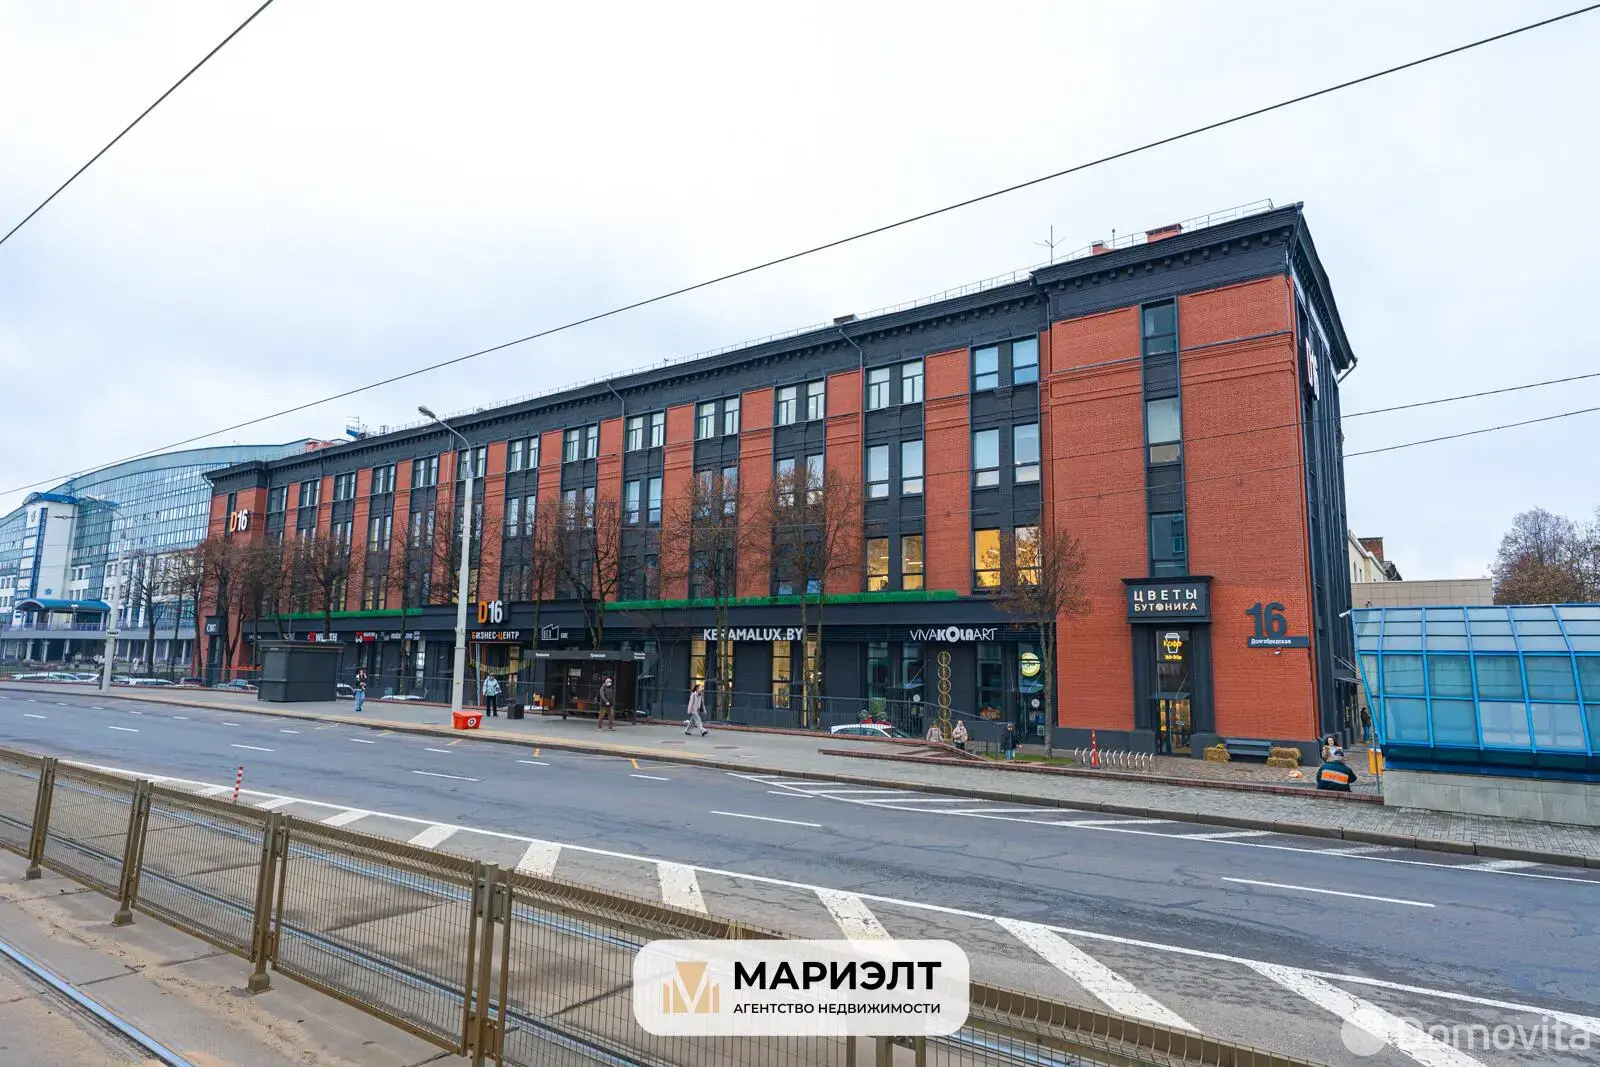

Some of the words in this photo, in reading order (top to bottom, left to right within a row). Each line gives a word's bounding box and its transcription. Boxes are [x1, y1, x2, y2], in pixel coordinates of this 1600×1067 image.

[229, 509, 249, 532] D16
[1133, 589, 1197, 602] ЦВЕТЫ
[477, 600, 503, 624] D16
[1134, 603, 1198, 612] БУТОНИКА
[1245, 601, 1288, 638] 16
[471, 631, 520, 640] БИЗНЕС-ЦЕНТР
